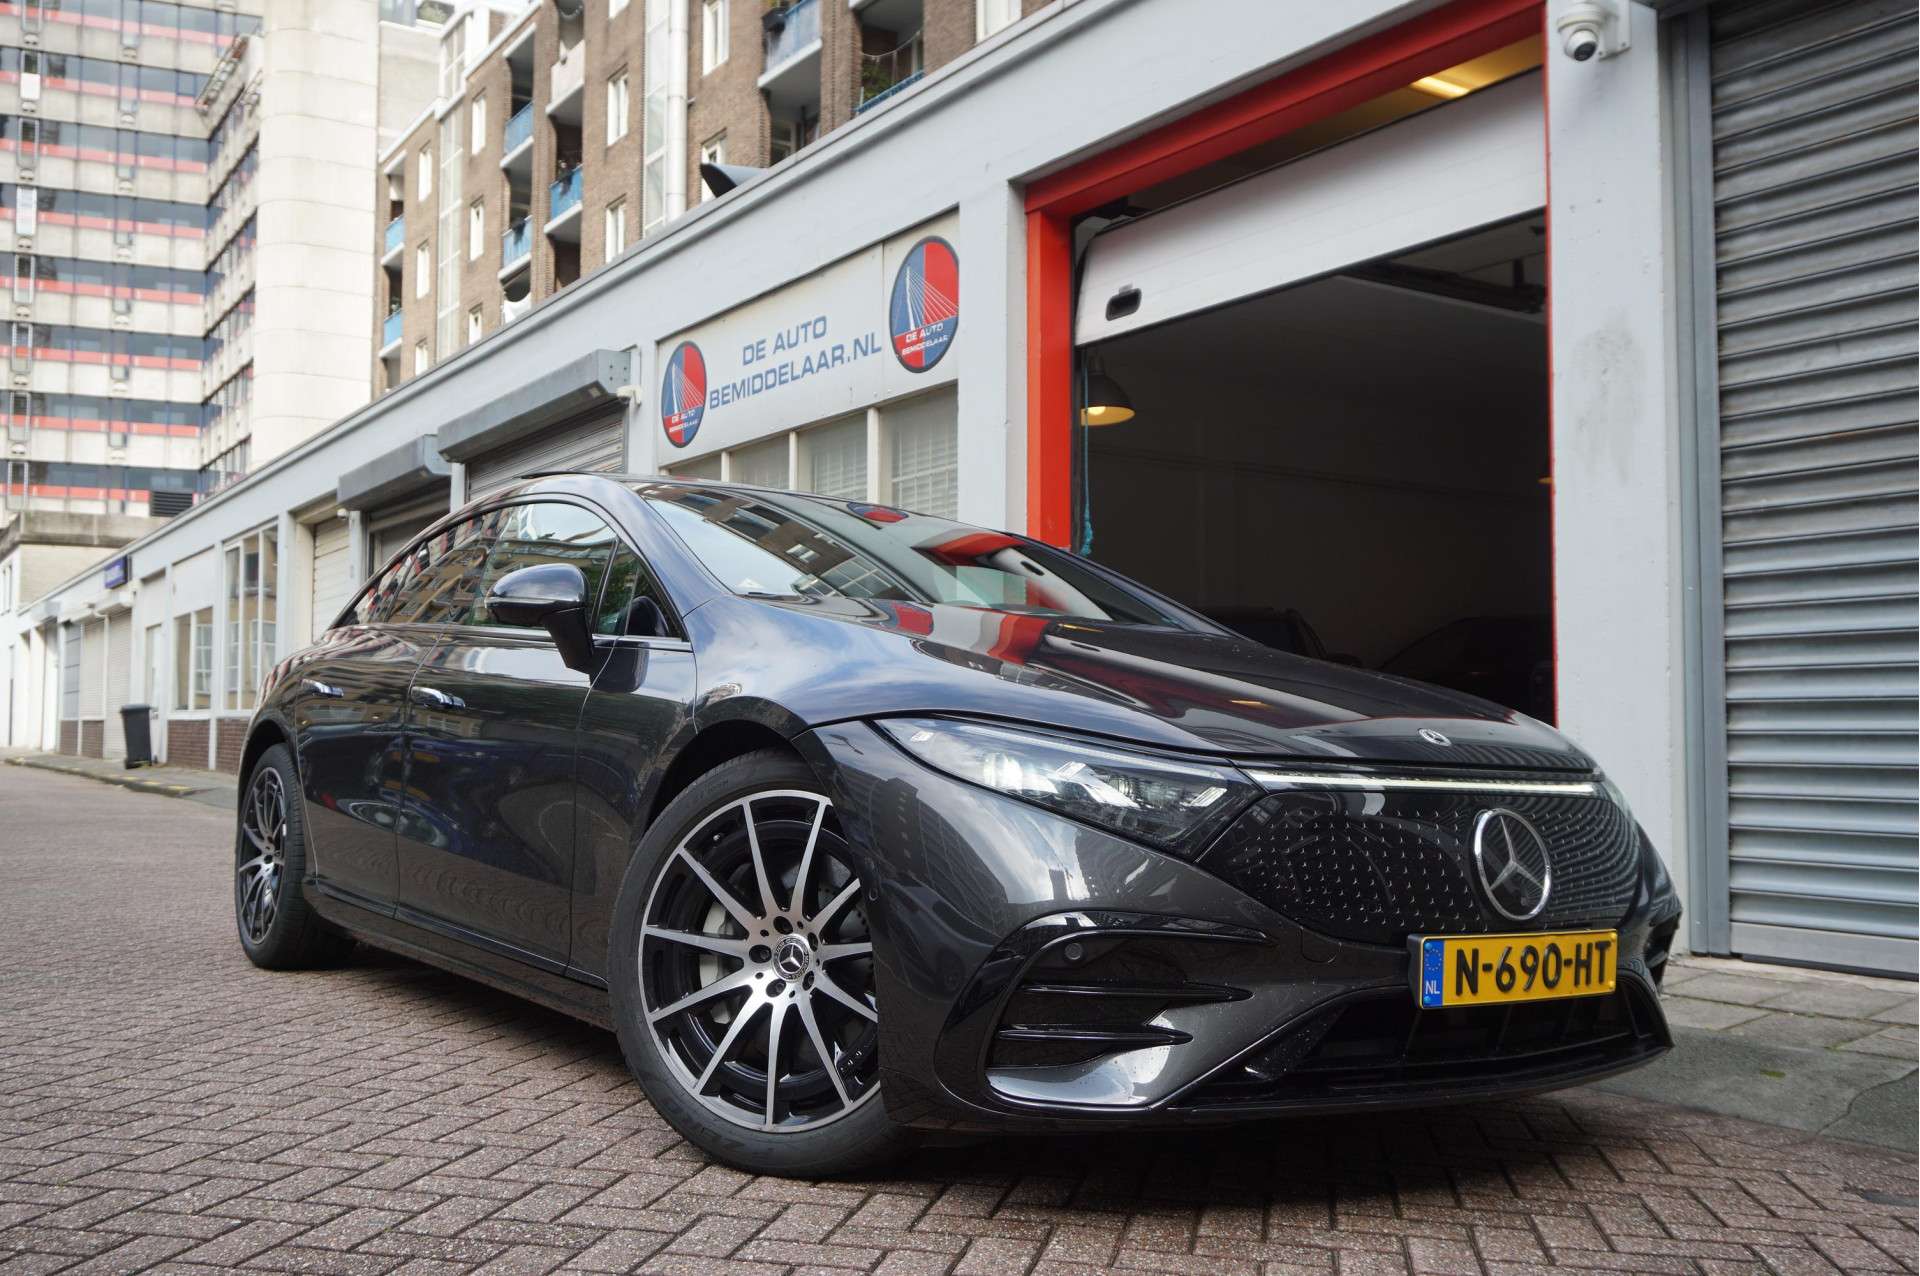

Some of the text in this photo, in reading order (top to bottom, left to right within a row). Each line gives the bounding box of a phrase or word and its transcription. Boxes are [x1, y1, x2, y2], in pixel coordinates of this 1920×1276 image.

[742, 316, 827, 365] DE AUTO
[905, 322, 944, 343] DE AUTO
[709, 332, 882, 410] BEMIDDELAAR.NL
[1425, 980, 1440, 995] NL
[1456, 940, 1612, 996] N-690-HT
